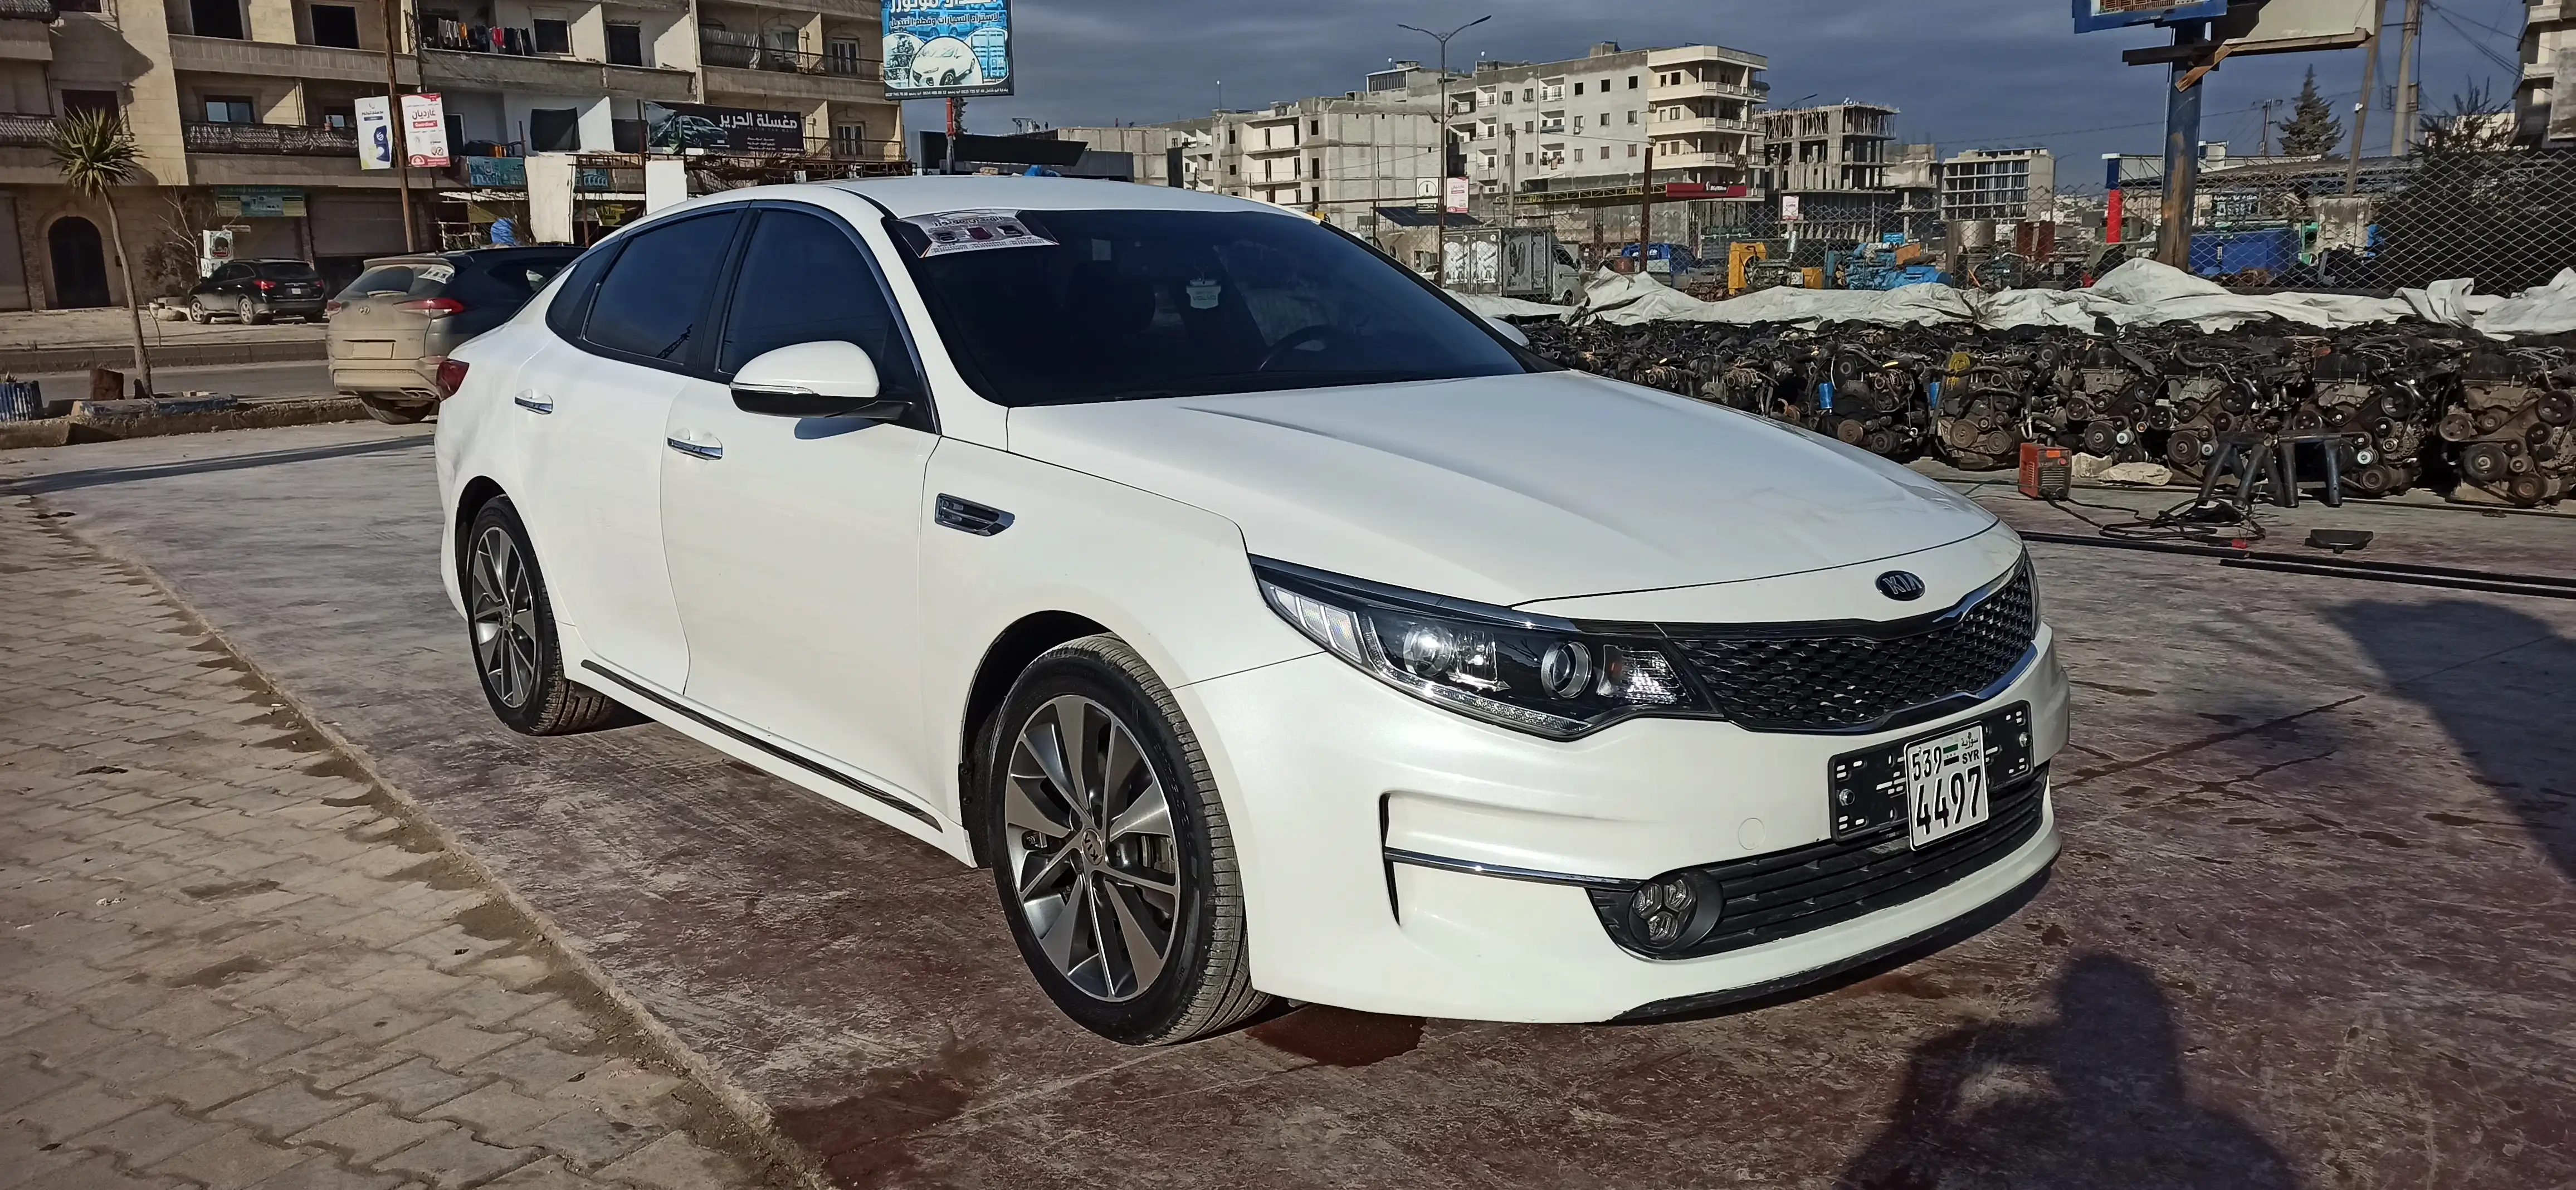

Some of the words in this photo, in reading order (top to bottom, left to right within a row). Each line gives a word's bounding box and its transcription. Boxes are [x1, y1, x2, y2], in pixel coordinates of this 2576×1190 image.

[412, 108, 436, 120] غارديان
[719, 112, 753, 129] الحرير
[757, 113, 798, 129] مغسلة
[1882, 573, 1923, 595] KIA
[1961, 738, 1979, 750] سورية
[1911, 745, 1942, 781] 539
[1962, 749, 1979, 764] SYR
[1914, 765, 1982, 835] 4497
